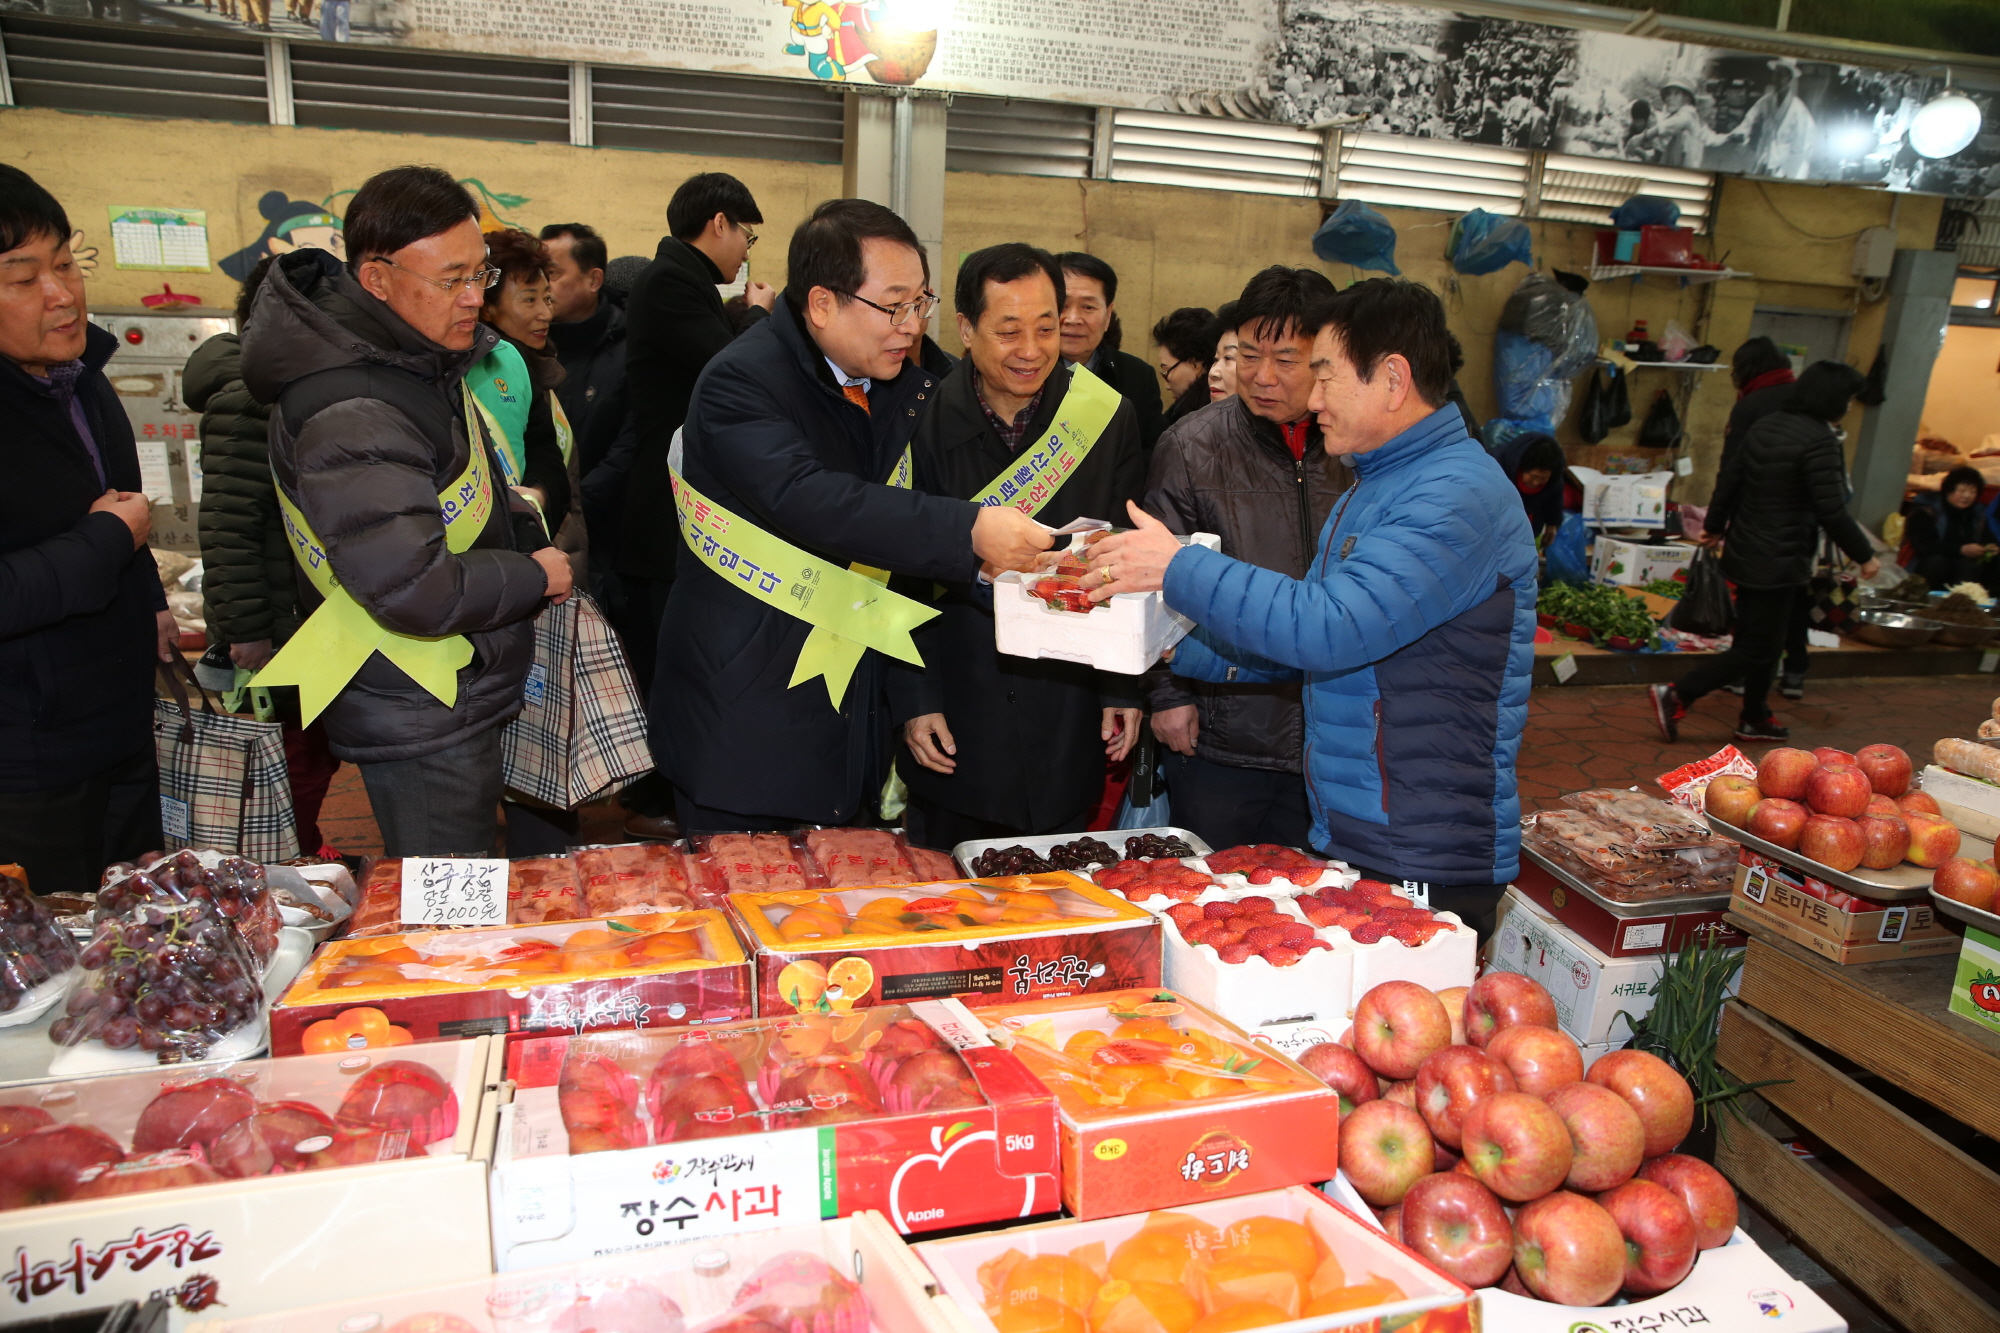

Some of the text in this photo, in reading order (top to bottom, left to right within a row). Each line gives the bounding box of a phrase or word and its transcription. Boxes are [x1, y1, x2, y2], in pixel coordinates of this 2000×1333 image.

[690, 523, 782, 594] 시작입니다
[464, 887, 494, 903] 보장
[1770, 885, 1829, 928] 토마토
[1813, 937, 1825, 951] 5kg
[1007, 954, 1092, 995] 한라봉
[1611, 982, 1649, 997] 서귀포
[1005, 1134, 1035, 1152] 5kg
[1099, 1144, 1121, 1155] 3kg
[684, 1153, 755, 1187] 장수만세
[1181, 1148, 1250, 1181] 레드향
[620, 1184, 783, 1236] 장수사과
[906, 1208, 945, 1223] Apple
